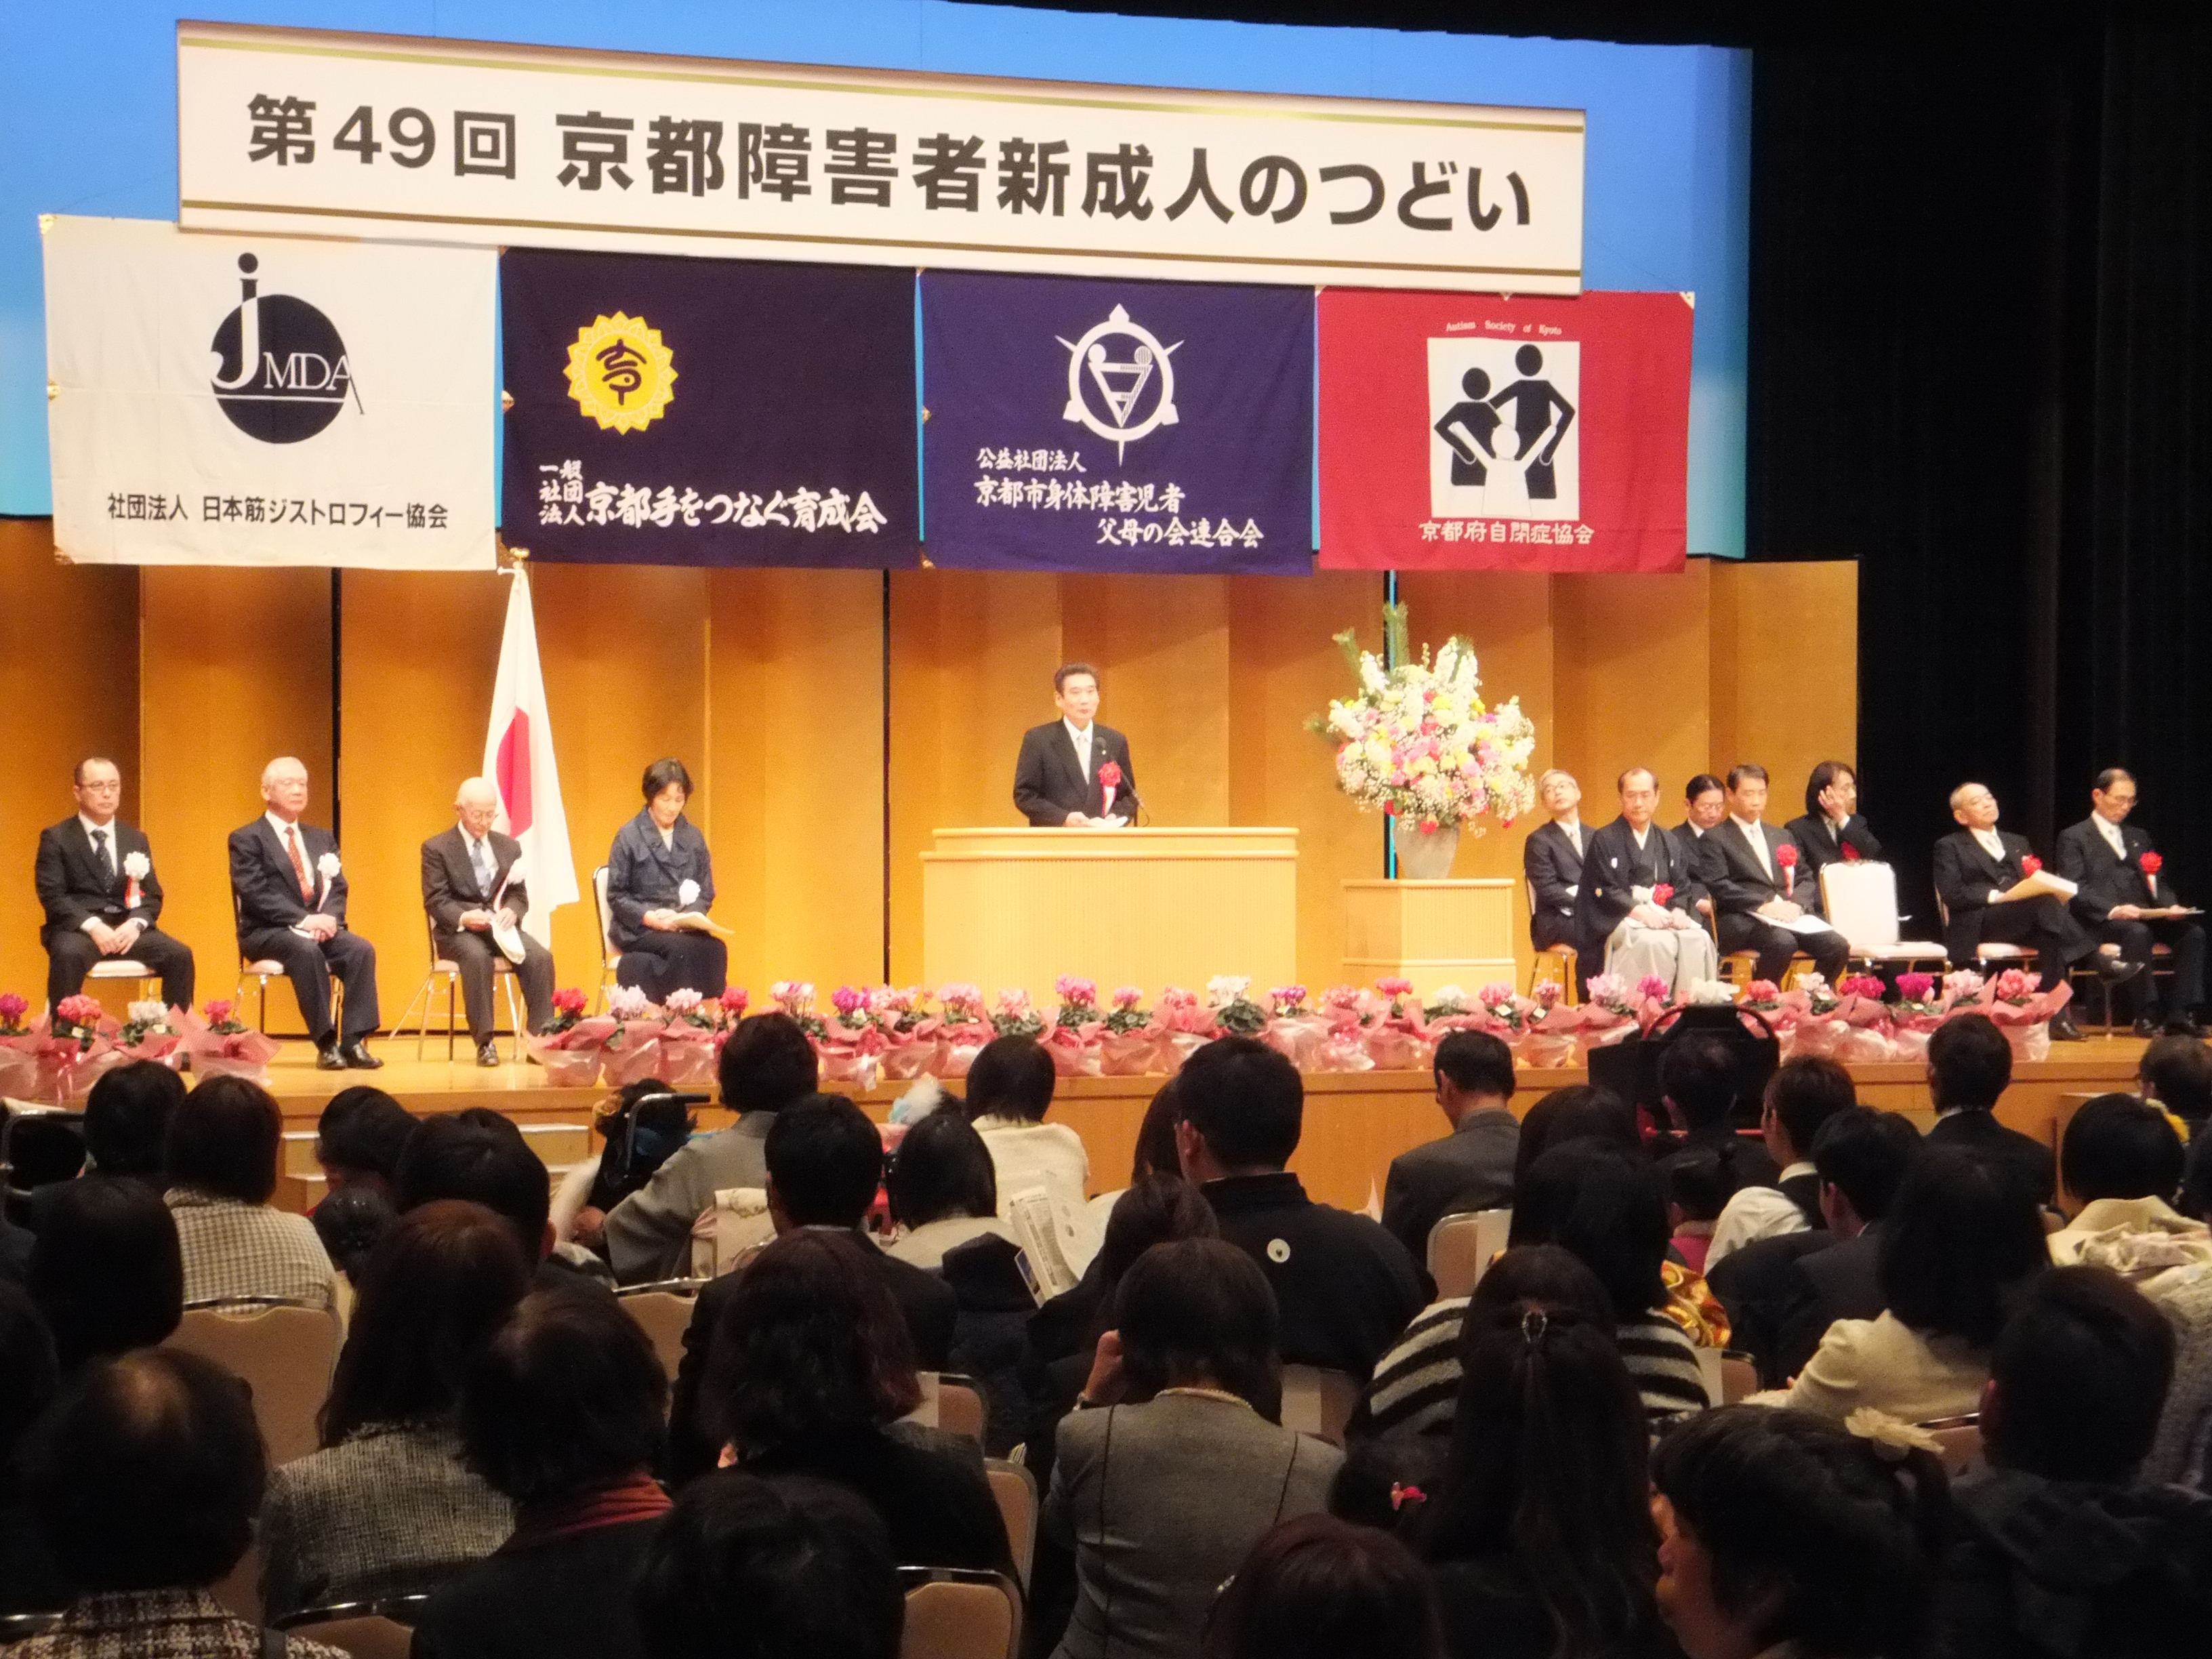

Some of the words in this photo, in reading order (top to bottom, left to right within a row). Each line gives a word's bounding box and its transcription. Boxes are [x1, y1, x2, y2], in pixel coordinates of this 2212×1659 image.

[247, 92, 516, 180] 第49回
[555, 110, 1530, 232] 京都障害者新成人のつどい
[1446, 321, 1477, 332] Autism
[1484, 319, 1517, 334] Society
[1522, 323, 1532, 333] of
[1538, 324, 1563, 336] Kyoto
[976, 447, 1088, 473] 公益社団法人
[539, 478, 584, 504] 社団
[973, 474, 1186, 514] 京都市身体障害児者
[107, 491, 188, 521] 社団法人
[203, 495, 449, 529] 日本筋ジストロフィー協会
[538, 502, 586, 527] 法人
[585, 480, 888, 533] 京都手をつなぐ育成会
[1097, 516, 1265, 549] 父母の会連合会
[1418, 519, 1595, 545] 京都府自閉症協会
